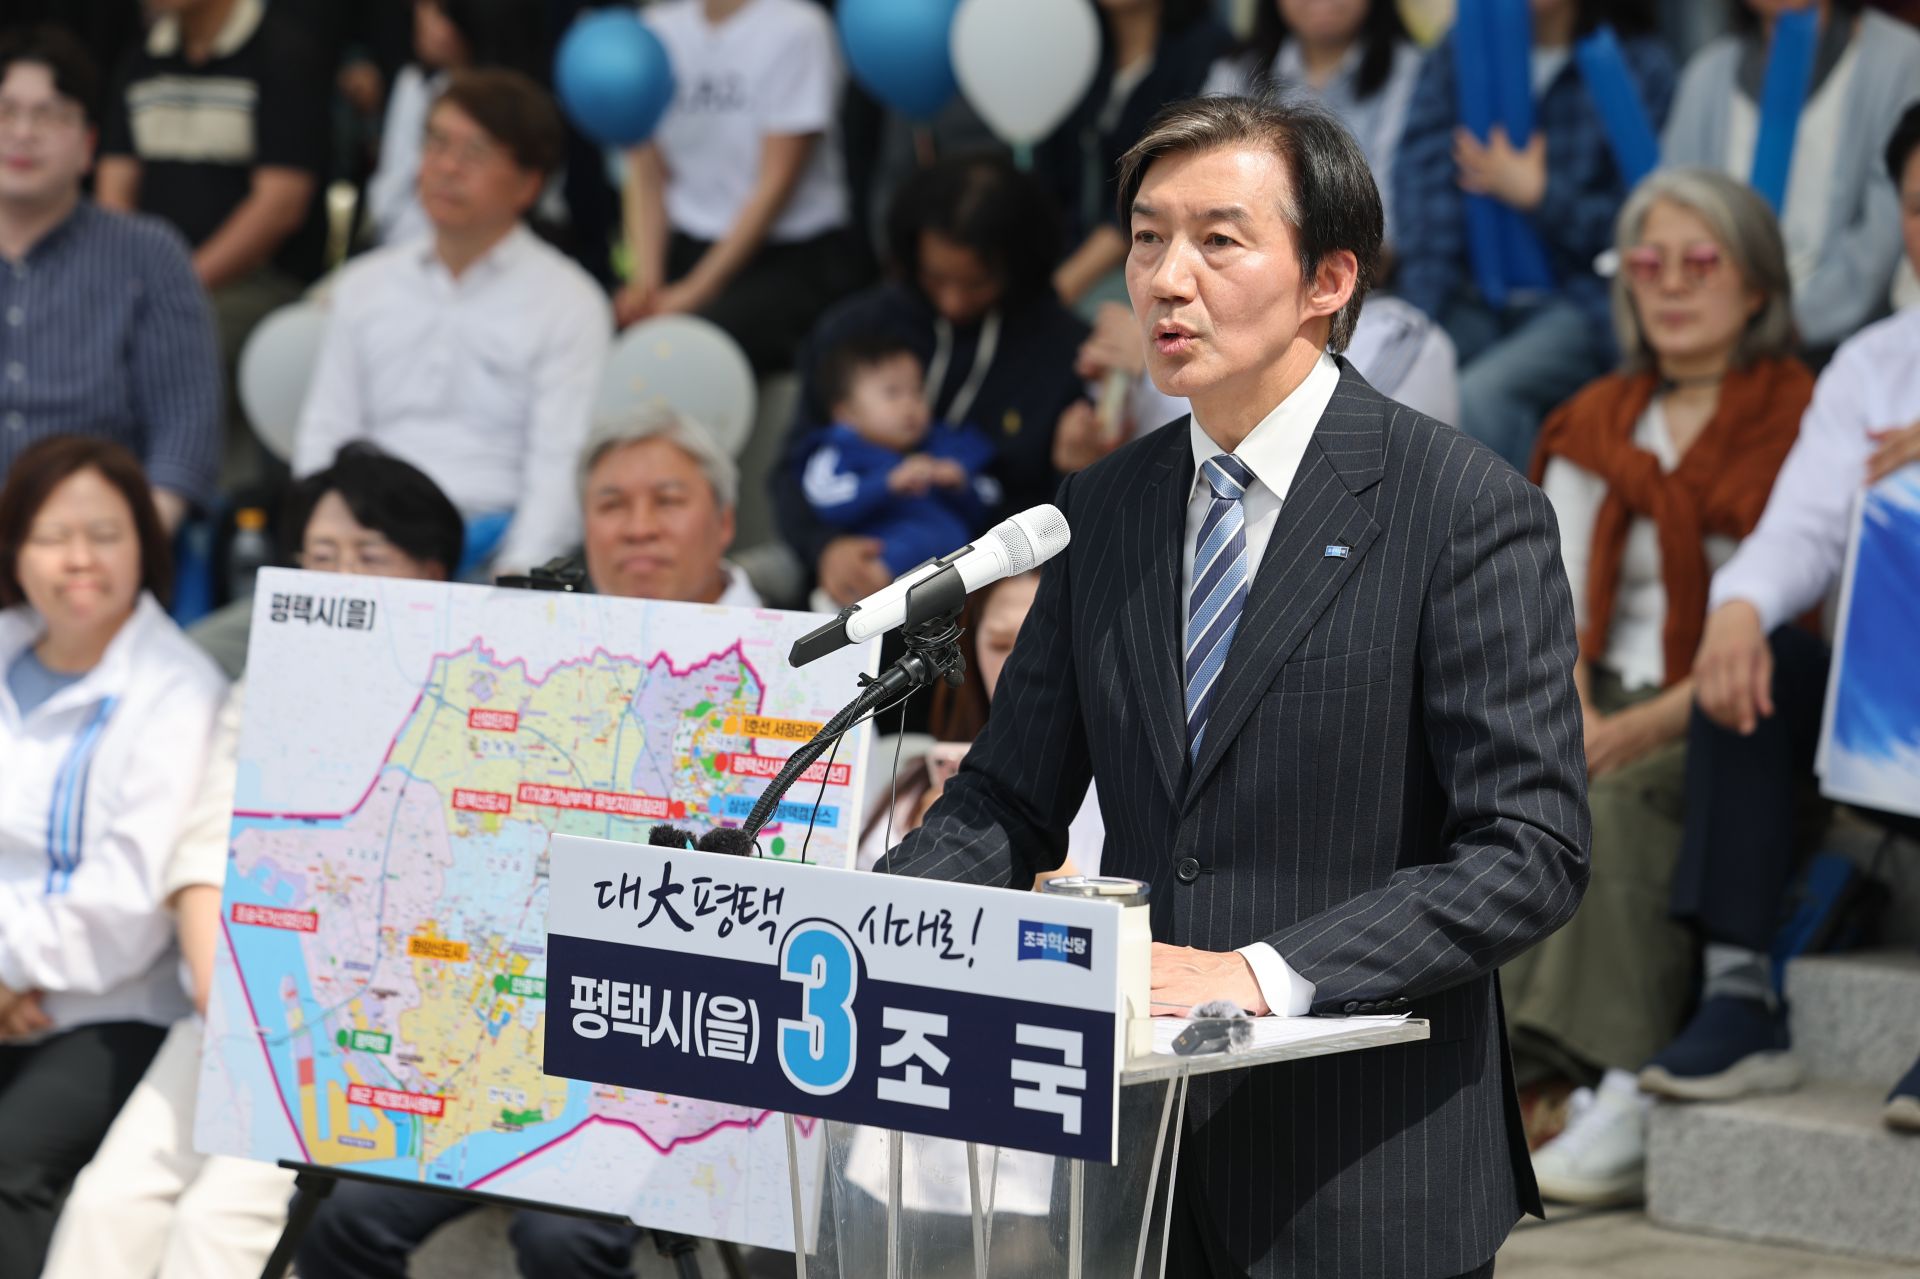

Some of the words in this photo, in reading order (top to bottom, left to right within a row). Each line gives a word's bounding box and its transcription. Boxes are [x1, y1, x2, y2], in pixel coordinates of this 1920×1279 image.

[269, 592, 376, 631] 평택시(을)
[593, 861, 785, 946] 대大평택
[857, 901, 985, 968] 시대로!
[1023, 930, 1087, 955] 조국혁신당
[569, 975, 760, 1064] 평택시(을)
[777, 921, 857, 1096] 3
